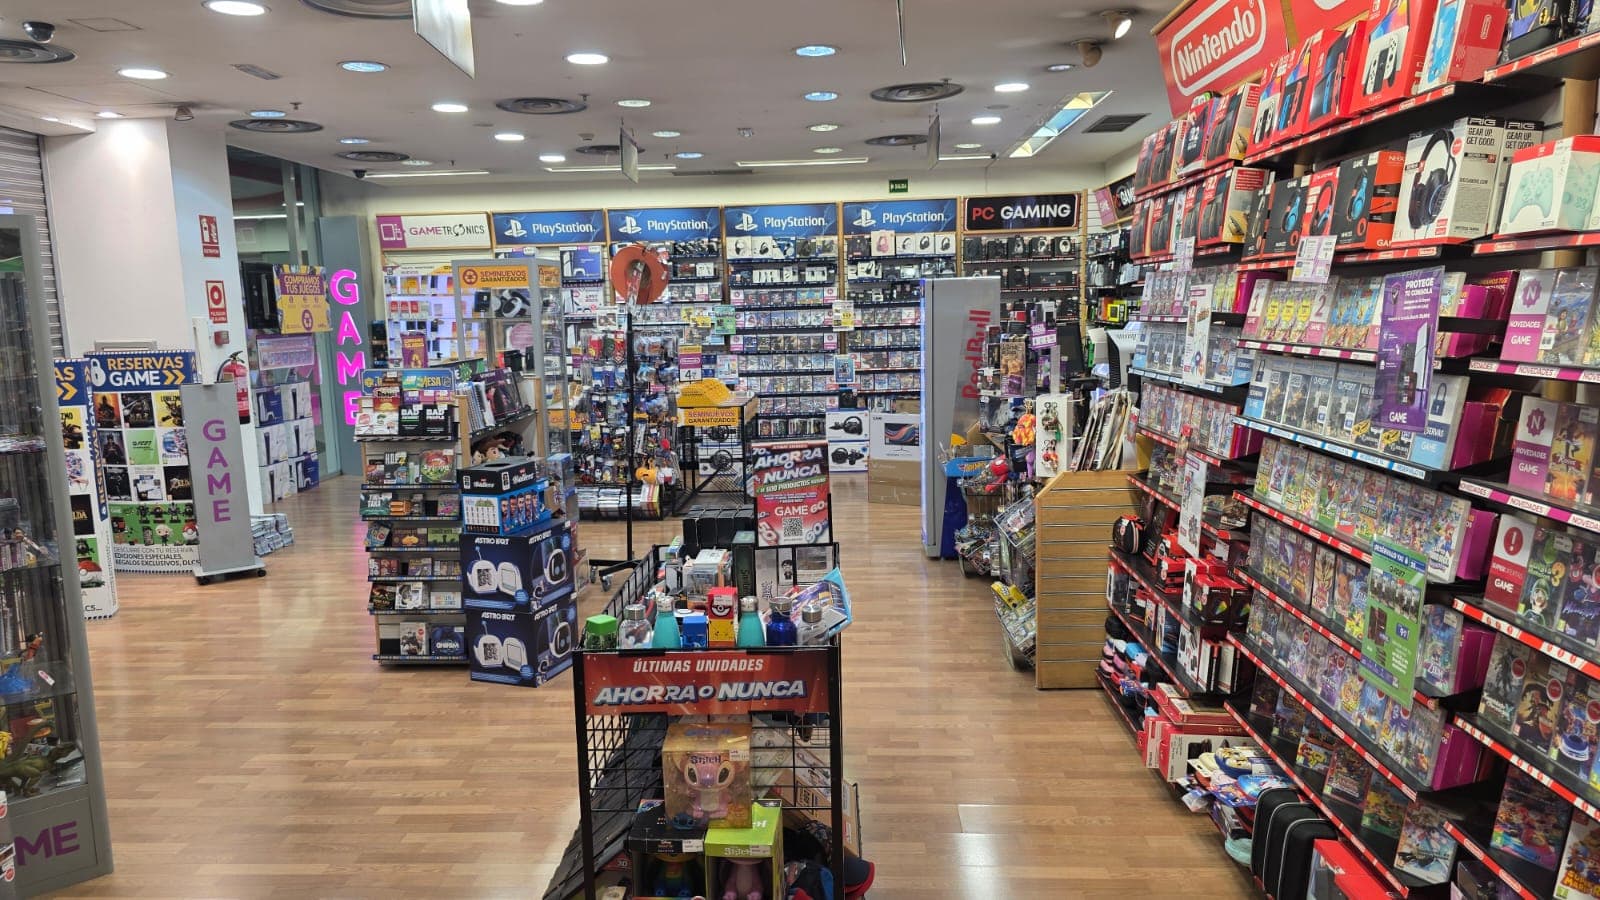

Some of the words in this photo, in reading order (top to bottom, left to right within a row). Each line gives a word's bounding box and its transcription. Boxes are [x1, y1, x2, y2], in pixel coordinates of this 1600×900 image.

[1177, 7, 1256, 81] Nintendo
[1469, 117, 1497, 127] RIG
[1508, 122, 1536, 130] RIG
[1468, 127, 1484, 136] GEAR
[1506, 131, 1522, 140] GEAR
[1466, 136, 1478, 145] GET
[1505, 140, 1518, 149] GET
[882, 210, 946, 223] PlayStation
[972, 207, 995, 221] PC
[1001, 204, 1072, 220] GAMING
[532, 221, 596, 235] PlayStation
[647, 218, 710, 232] PlayStation
[764, 216, 827, 229] PlayStation
[409, 223, 485, 237] GAMETRONICS
[284, 275, 320, 284] COMPRAMOS
[480, 270, 527, 278] SEMINUEVOS
[285, 284, 299, 294] TUS
[299, 284, 320, 294] JUEGOS
[1405, 277, 1434, 290] PROTEGE
[1411, 288, 1433, 297] CONSOLA
[1315, 294, 1326, 318] 2
[1510, 320, 1541, 329] NOVEDADES
[1510, 335, 1532, 345] GAME
[330, 269, 366, 425] GAME
[107, 356, 184, 371] RESERVAS
[109, 370, 161, 387] GAME
[1519, 367, 1553, 377] NOVEDADES
[401, 408, 420, 416] BAD
[425, 408, 445, 416] BAD
[1388, 411, 1408, 424] GAME
[754, 447, 823, 469] AHORRA
[1515, 447, 1547, 460] NOVEDADES
[202, 419, 232, 523] GAME
[784, 460, 794, 469] O
[1518, 462, 1540, 476] GAME
[763, 463, 822, 485] NUNCA
[774, 504, 809, 517] GAME
[1510, 497, 1545, 513] NOVEDADES
[475, 537, 495, 545] ASTRO
[496, 537, 511, 545] BOT
[529, 533, 543, 545] ASTRO
[1494, 578, 1514, 593] GAME
[481, 611, 502, 620] ASTRO
[502, 612, 516, 621] BOT
[534, 607, 548, 621] ASTRO
[632, 658, 691, 673] ÚLTIMAS
[695, 658, 764, 672] UNIDADES
[593, 683, 697, 705] AHORRA
[717, 679, 806, 701] NUNCA
